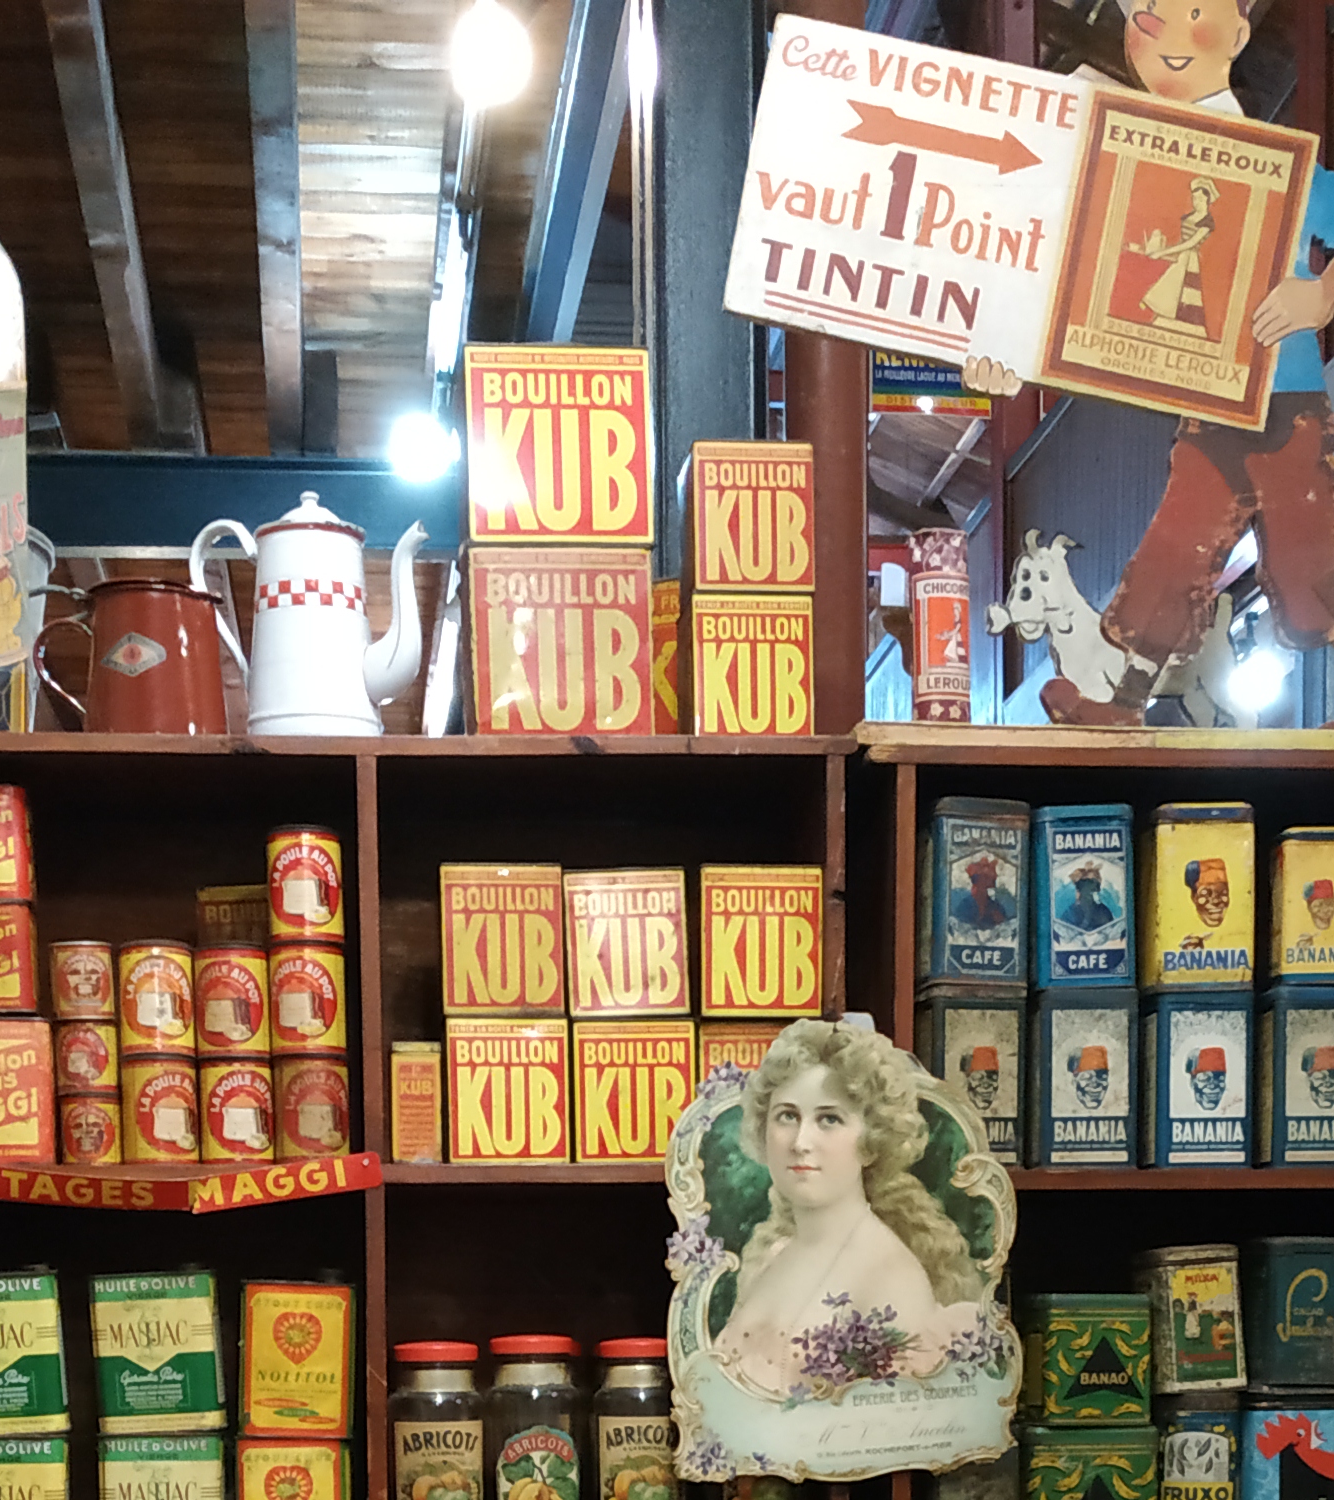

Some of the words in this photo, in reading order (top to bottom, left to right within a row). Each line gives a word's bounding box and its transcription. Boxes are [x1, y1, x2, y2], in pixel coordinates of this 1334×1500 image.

[782, 34, 859, 82] Cette
[867, 48, 1079, 131] VIGNETTE
[756, 169, 872, 231] vaut
[880, 151, 918, 241] 1
[916, 179, 1046, 274] Point
[761, 237, 981, 332] TINTIN
[1137, 326, 1218, 352] GRAMMES
[1067, 328, 1159, 364] ALPHONSE
[1163, 355, 1243, 386] LEROUX
[483, 372, 632, 406] BOUILLON
[475, 407, 637, 532] KUB
[705, 462, 806, 488] BOUILLON
[704, 490, 809, 582] KUB
[485, 573, 637, 606] BOUILLON
[702, 616, 803, 640] BOUILLON
[486, 607, 640, 732] KUB
[703, 641, 808, 734] KUB
[952, 827, 1017, 846] BANANIA
[1054, 830, 1122, 852] BANANIA
[275, 846, 309, 870] POULE
[311, 849, 327, 864] AU
[321, 863, 338, 887] POT
[451, 886, 554, 911] BOUILLON
[573, 890, 677, 917] BOUILLON
[711, 889, 813, 913] BOUILLON
[452, 913, 558, 1005] KUB
[576, 917, 681, 1007] KUB
[711, 914, 815, 1006] KUB
[960, 946, 1003, 967] CAFÉ
[1067, 950, 1109, 970] CAFÉ
[1163, 948, 1253, 971] BANANIA
[455, 1040, 558, 1065] BOUILLON
[584, 1041, 685, 1066] BOUILLON
[399, 1080, 433, 1096] KUB
[457, 1066, 561, 1157] KUB
[585, 1066, 686, 1156] KUB
[1053, 1119, 1128, 1142] BANANIA
[1172, 1121, 1245, 1143] BANANIA
[189, 1159, 347, 1210] MAGGI
[1080, 1372, 1129, 1385] BANAO
[508, 1436, 569, 1459] ABRICOTS
